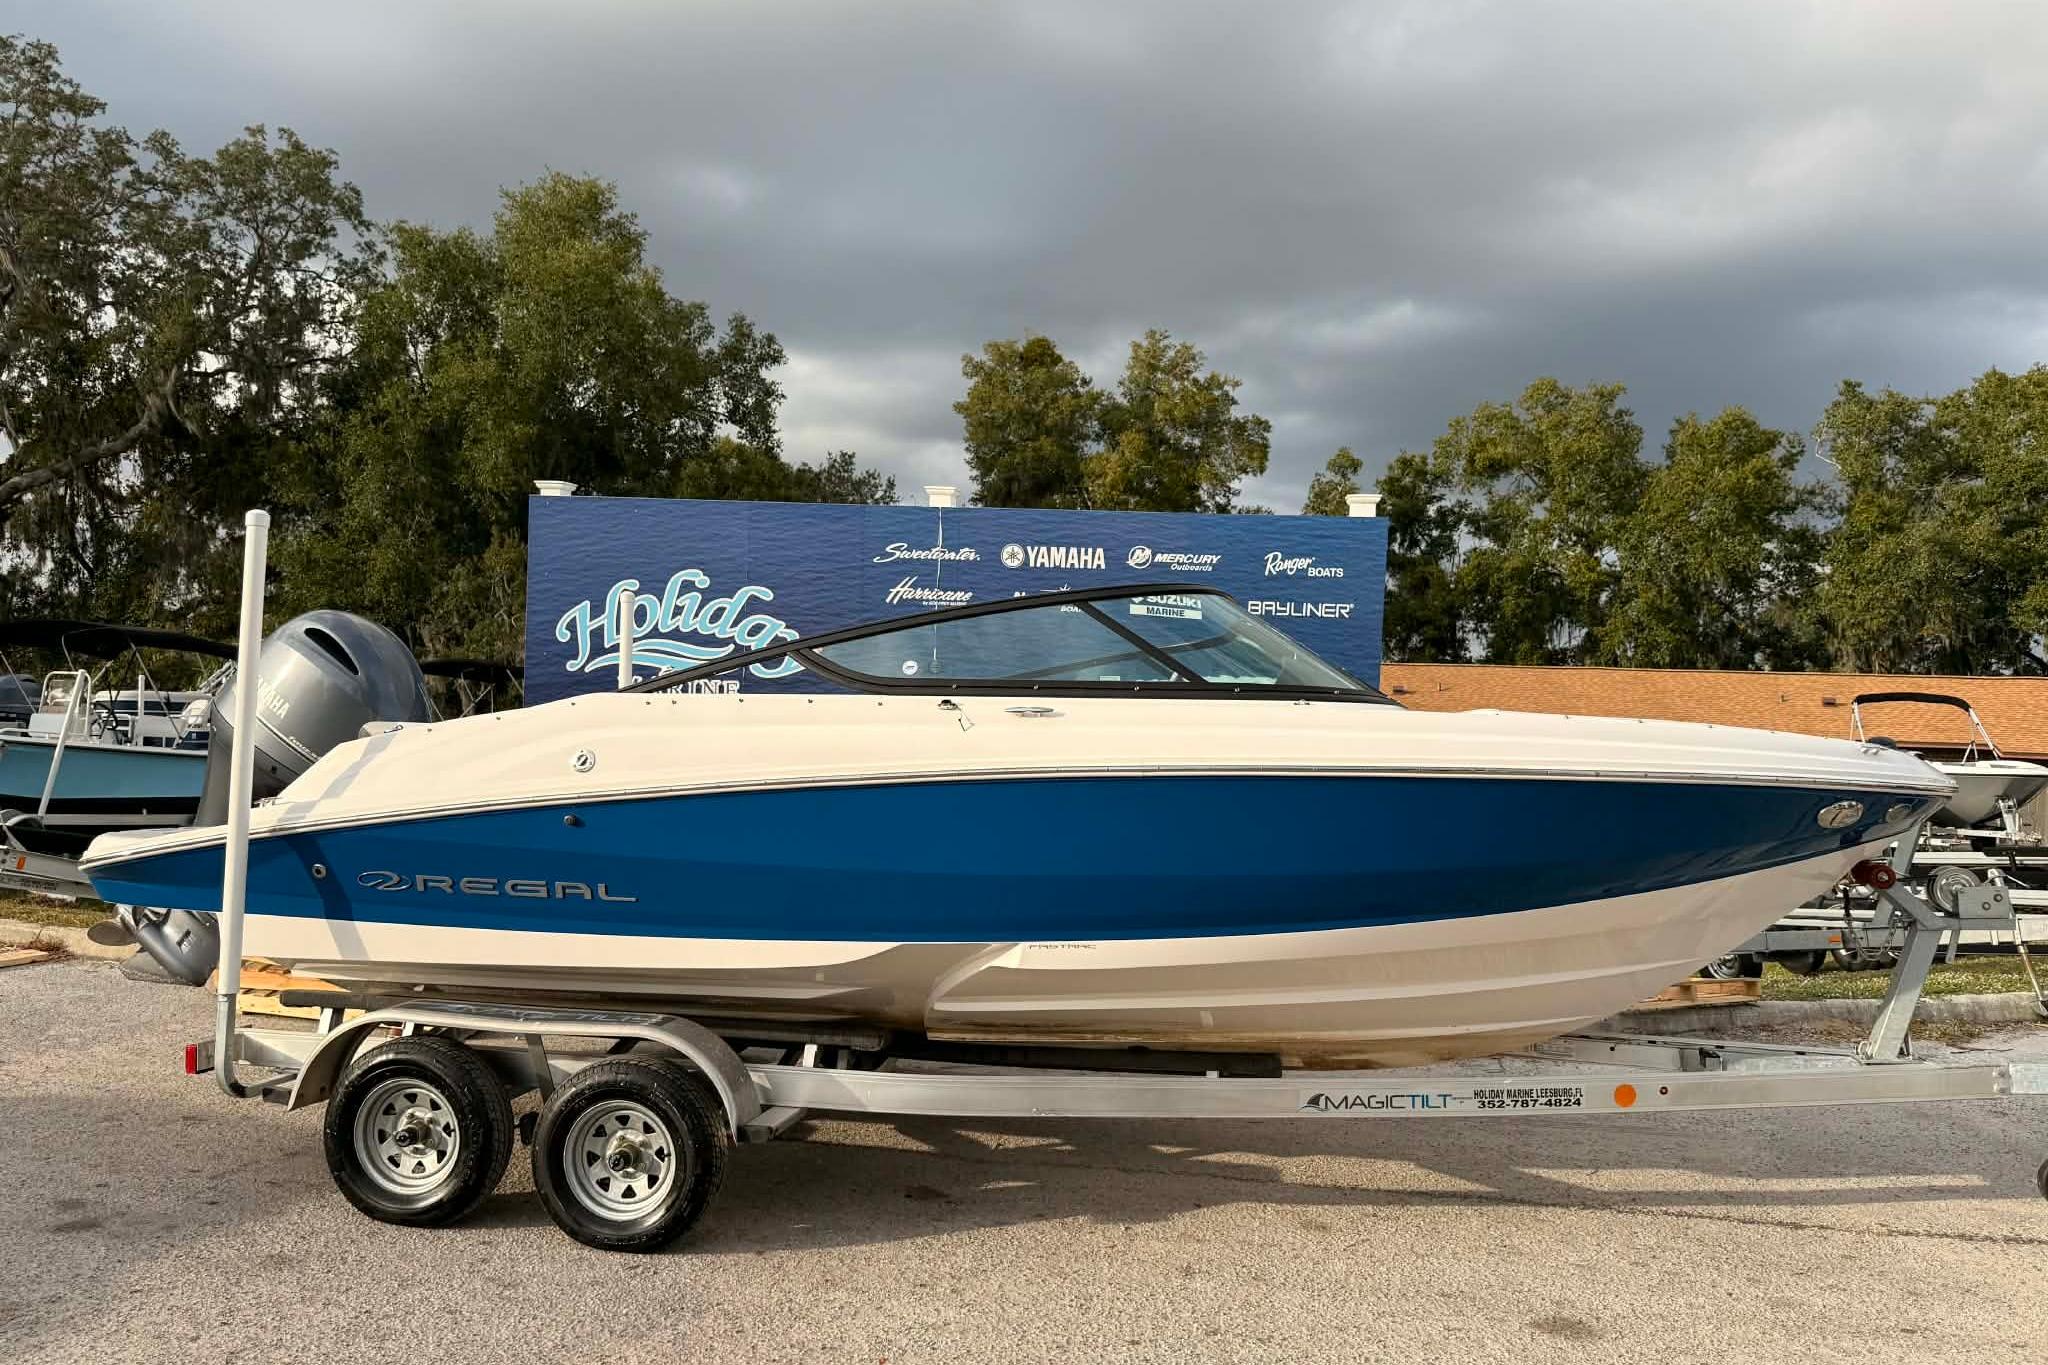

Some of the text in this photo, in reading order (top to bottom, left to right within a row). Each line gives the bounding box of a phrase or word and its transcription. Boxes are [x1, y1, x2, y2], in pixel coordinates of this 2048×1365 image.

[1026, 546, 1106, 570] YAMAHA
[1154, 553, 1222, 564] MERCURY
[1264, 551, 1344, 578] Ranger BOATS
[1170, 563, 1213, 572] Outboards
[886, 576, 974, 605] Hurricane
[1146, 606, 1185, 617] MARINE
[1247, 600, 1351, 619] BAYLINER
[415, 874, 639, 902] REGAL
[1324, 1093, 1453, 1110] MAGICTILT
[1473, 1089, 1505, 1100] HOLIDAY
[1506, 1088, 1534, 1099] MARINE
[1477, 1098, 1582, 1109] 352-787-4824
